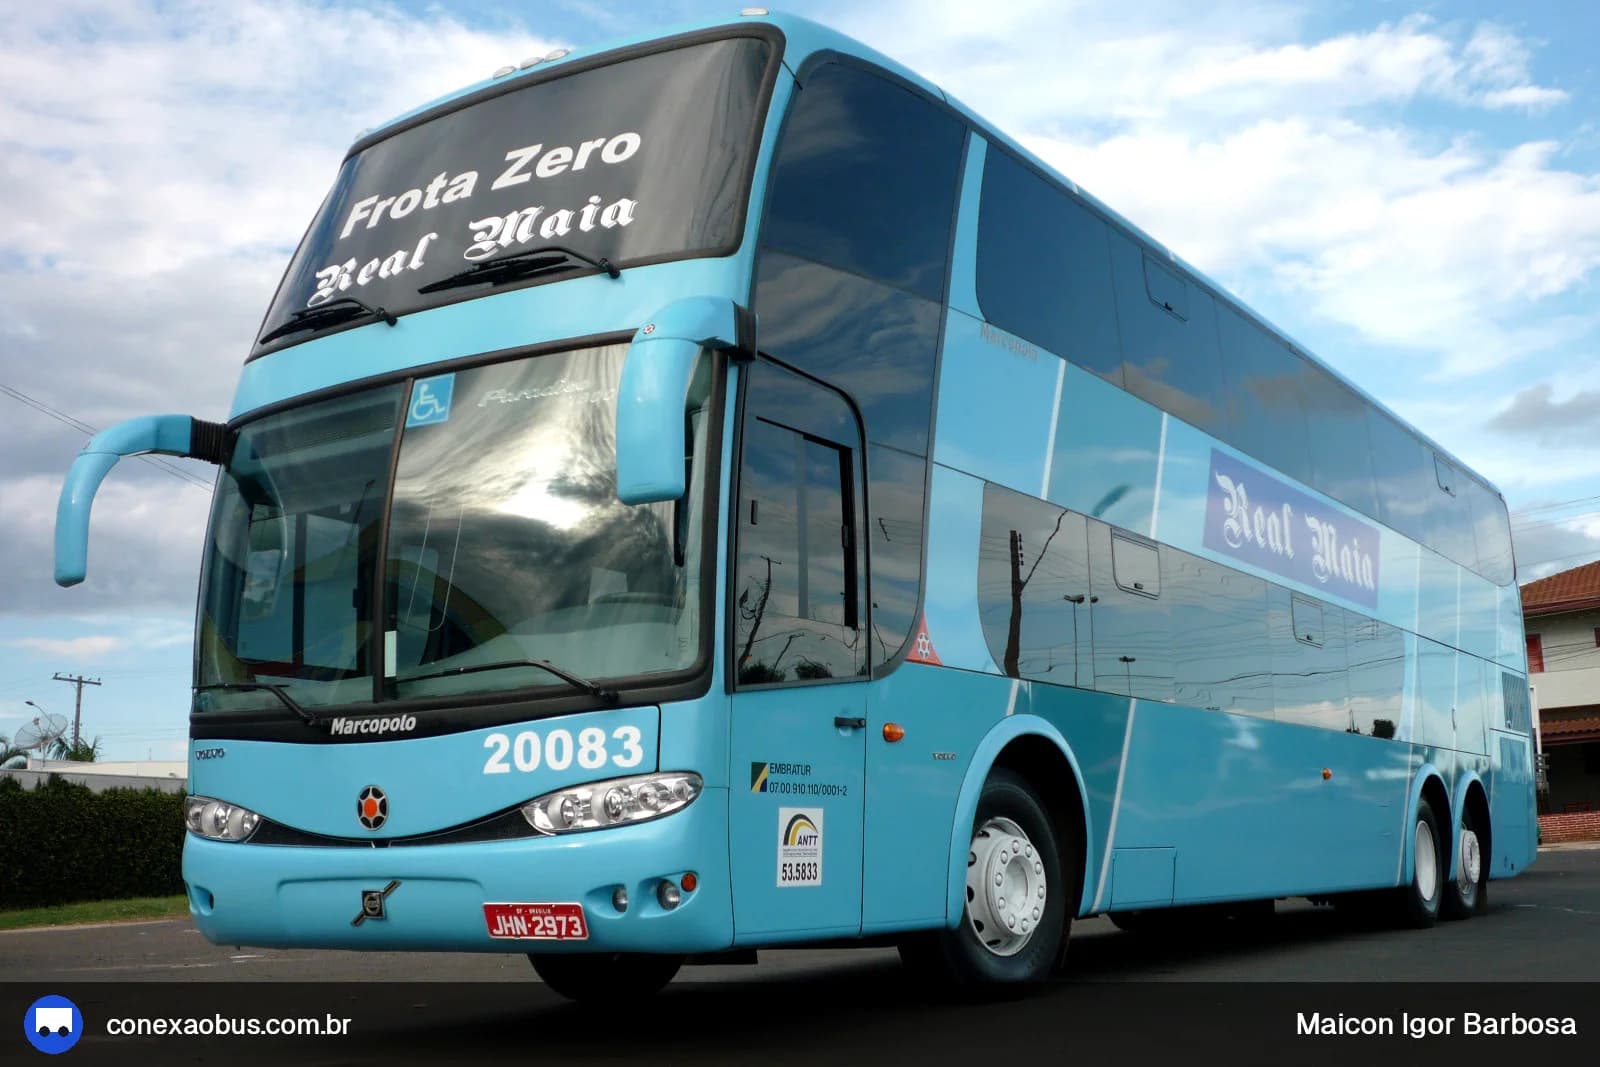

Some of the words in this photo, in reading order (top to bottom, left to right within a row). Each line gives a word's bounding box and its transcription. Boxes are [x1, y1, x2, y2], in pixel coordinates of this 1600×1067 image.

[339, 170, 479, 240] Frota
[491, 132, 641, 191] Zero
[307, 232, 439, 308] Real
[463, 195, 639, 260] Maia
[1215, 471, 1295, 559] Real
[1304, 512, 1375, 591] Maia
[331, 714, 417, 736] Marcopolo
[483, 726, 644, 775] 20083
[769, 763, 811, 776] EMBRATUR
[797, 834, 818, 846] ANTT
[782, 862, 818, 881] 53.5833
